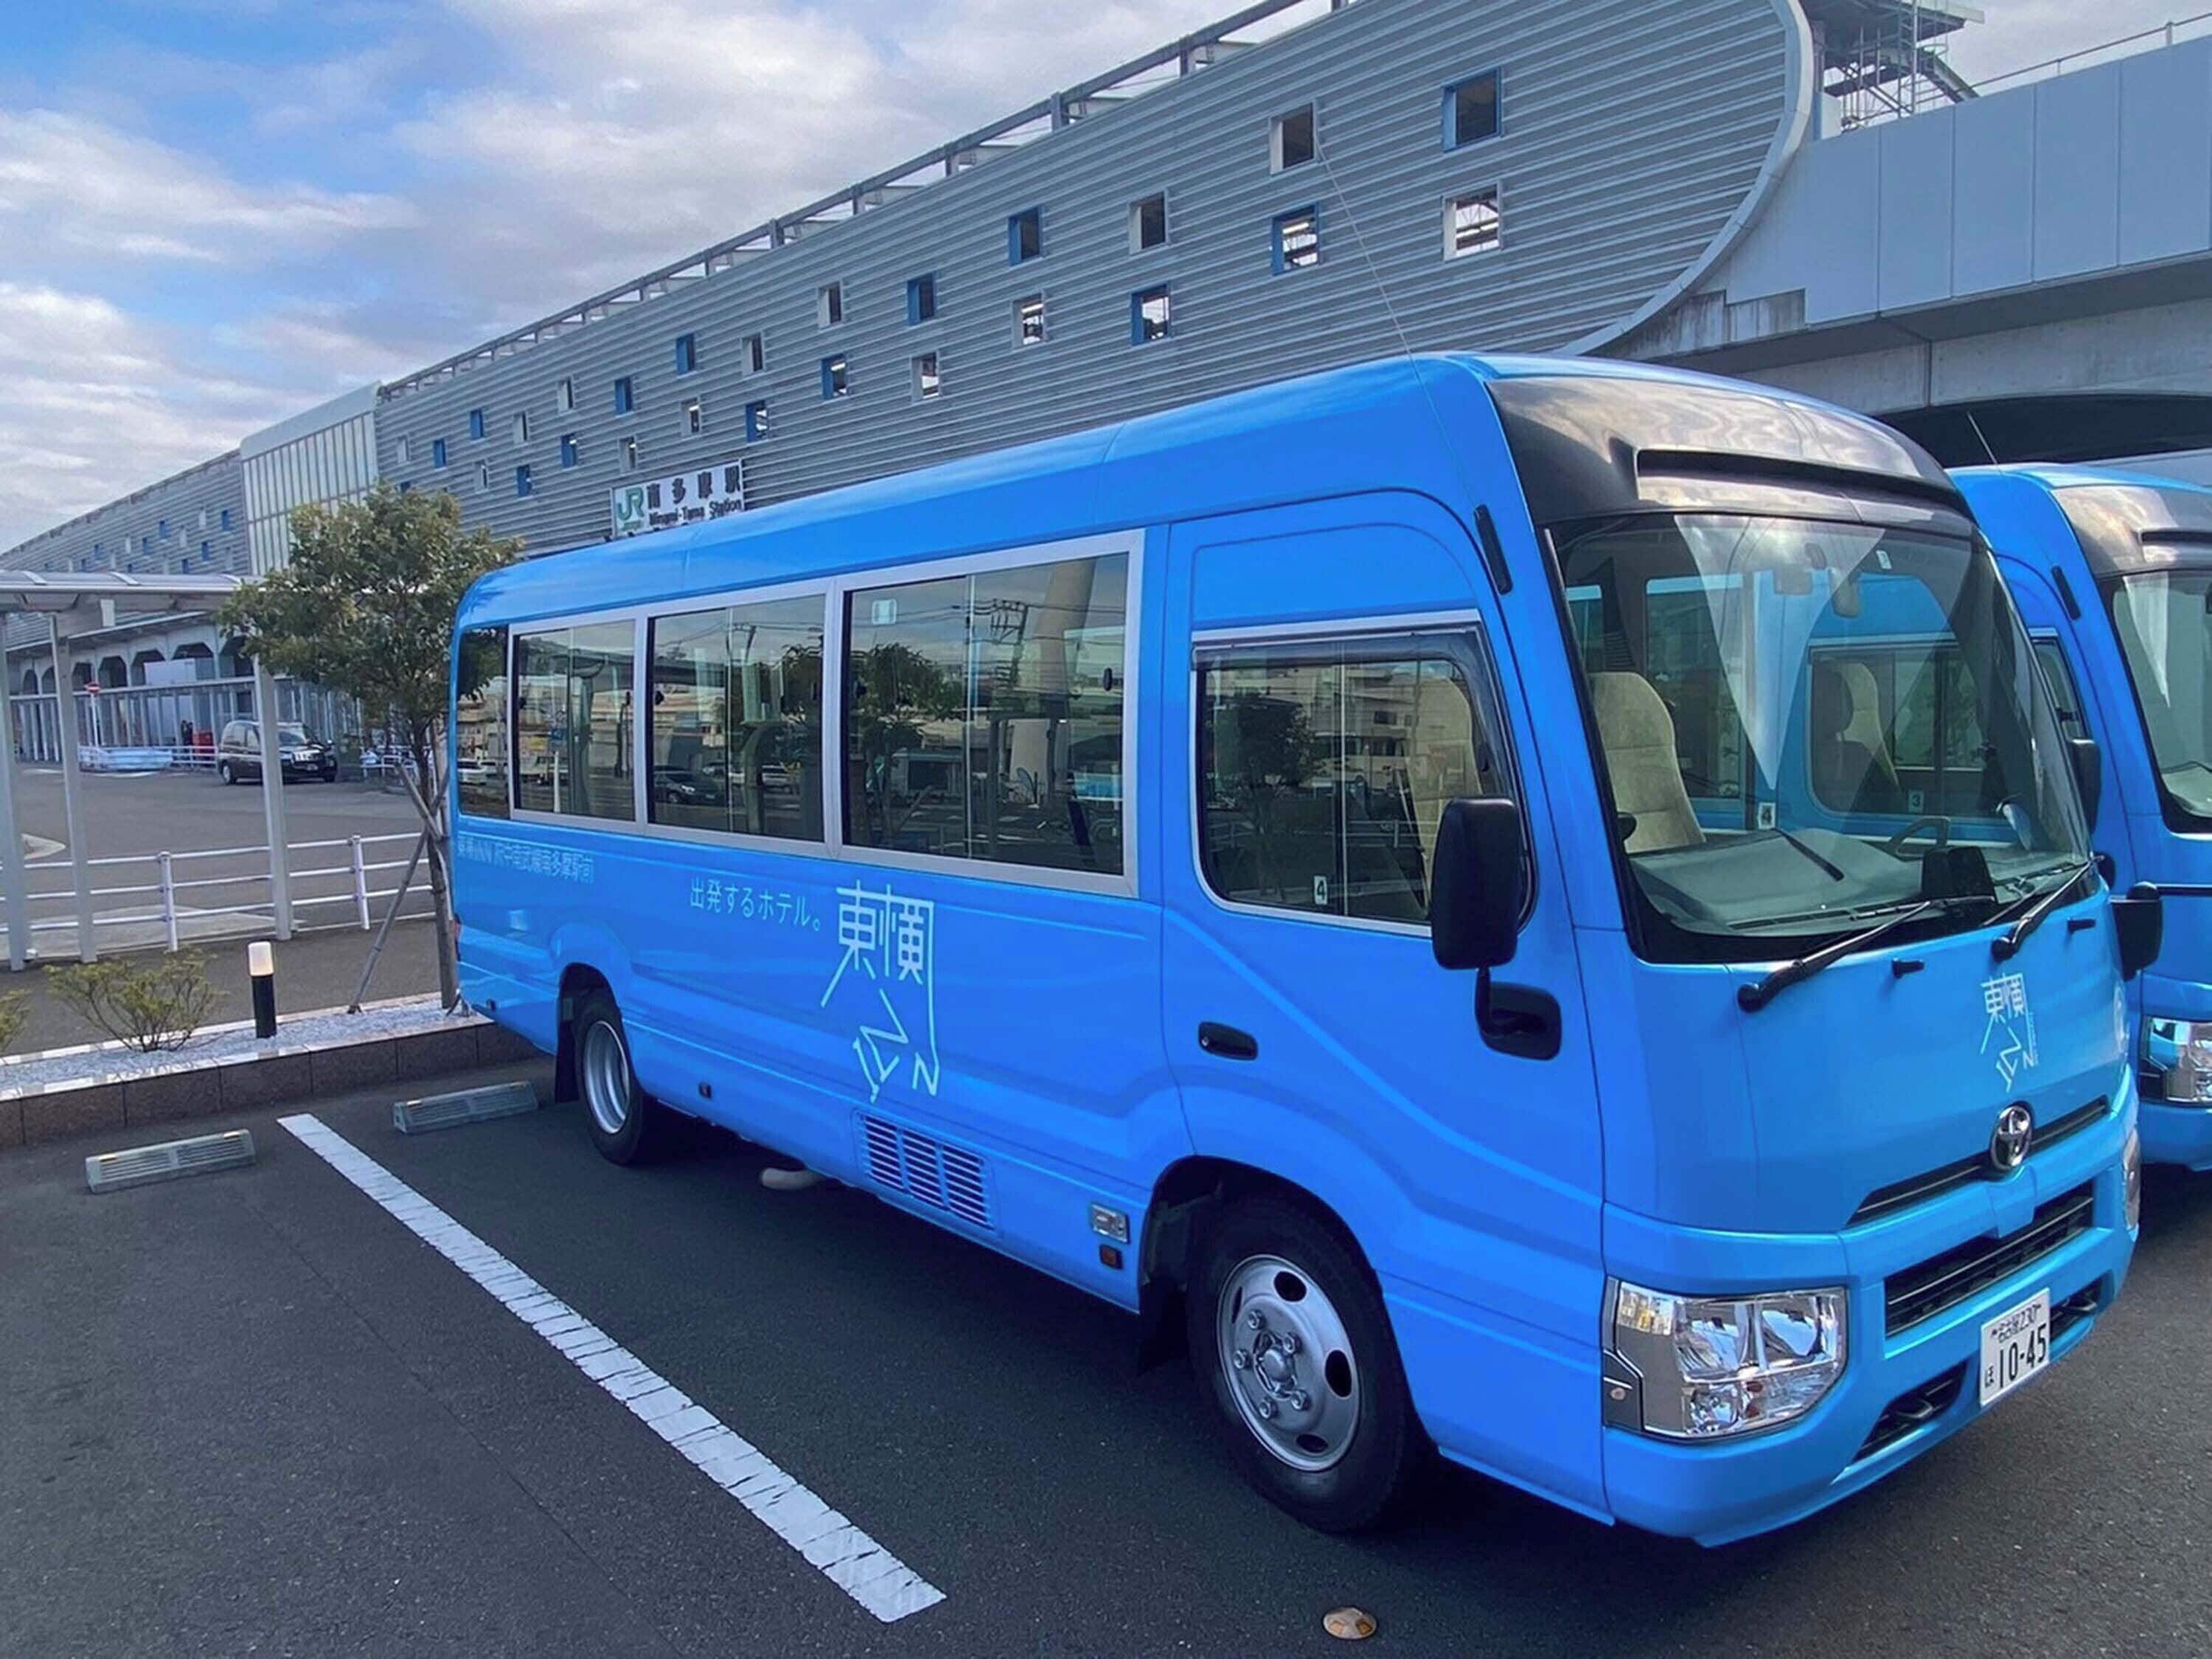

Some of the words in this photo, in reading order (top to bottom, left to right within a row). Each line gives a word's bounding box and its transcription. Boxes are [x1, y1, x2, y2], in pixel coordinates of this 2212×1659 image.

[617, 487, 644, 521] JR
[709, 499, 742, 520] Station
[1912, 794, 1921, 807] 3
[1761, 807, 1772, 824] 4
[1317, 880, 1326, 900] 4
[690, 877, 820, 932] 出発するホテル。
[2000, 1323, 2047, 1389] 10-45
